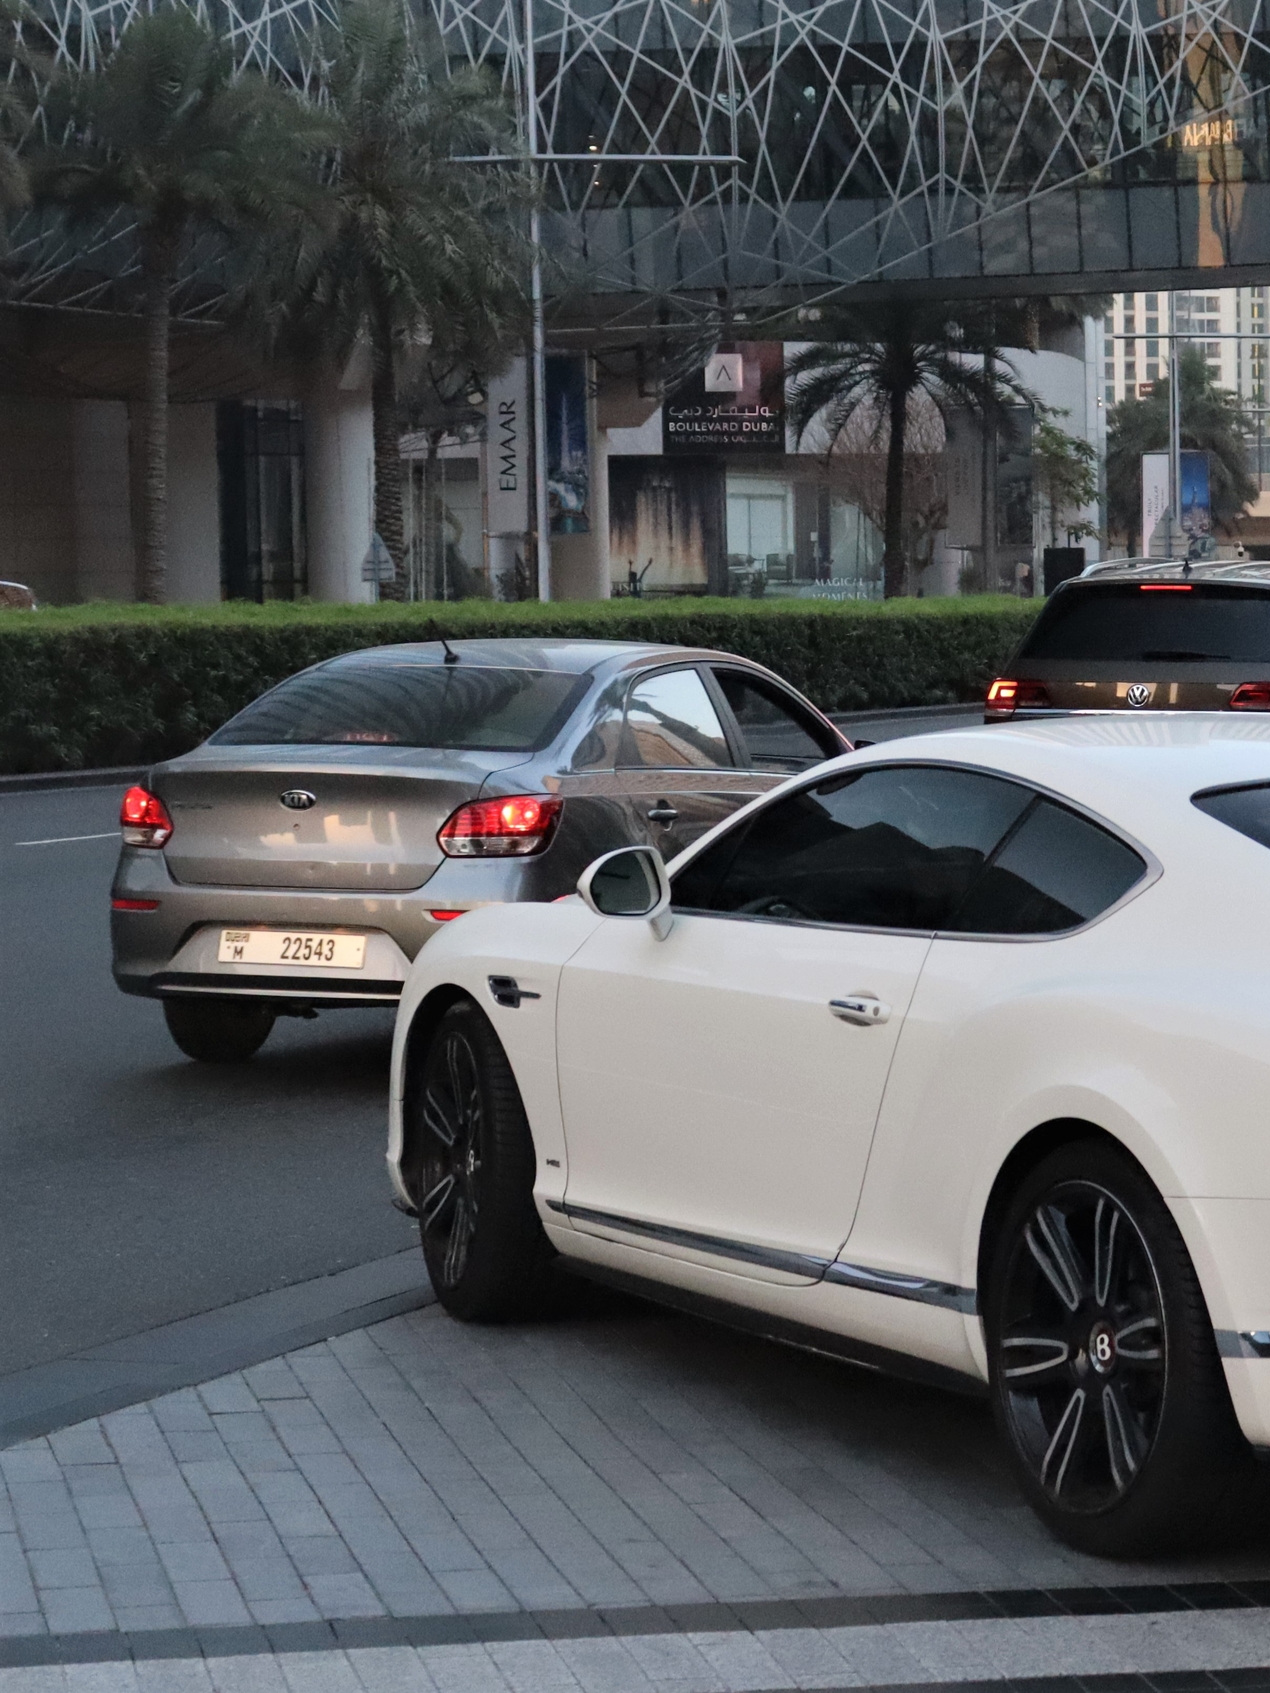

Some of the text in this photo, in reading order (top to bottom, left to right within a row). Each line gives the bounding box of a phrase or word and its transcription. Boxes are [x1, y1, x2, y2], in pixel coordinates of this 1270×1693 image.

[669, 422, 738, 431] BOULEVARD
[499, 400, 517, 490] EMAAR
[814, 577, 864, 587] MAGICAL
[284, 794, 310, 807] KIA
[233, 936, 335, 962] M 22543
